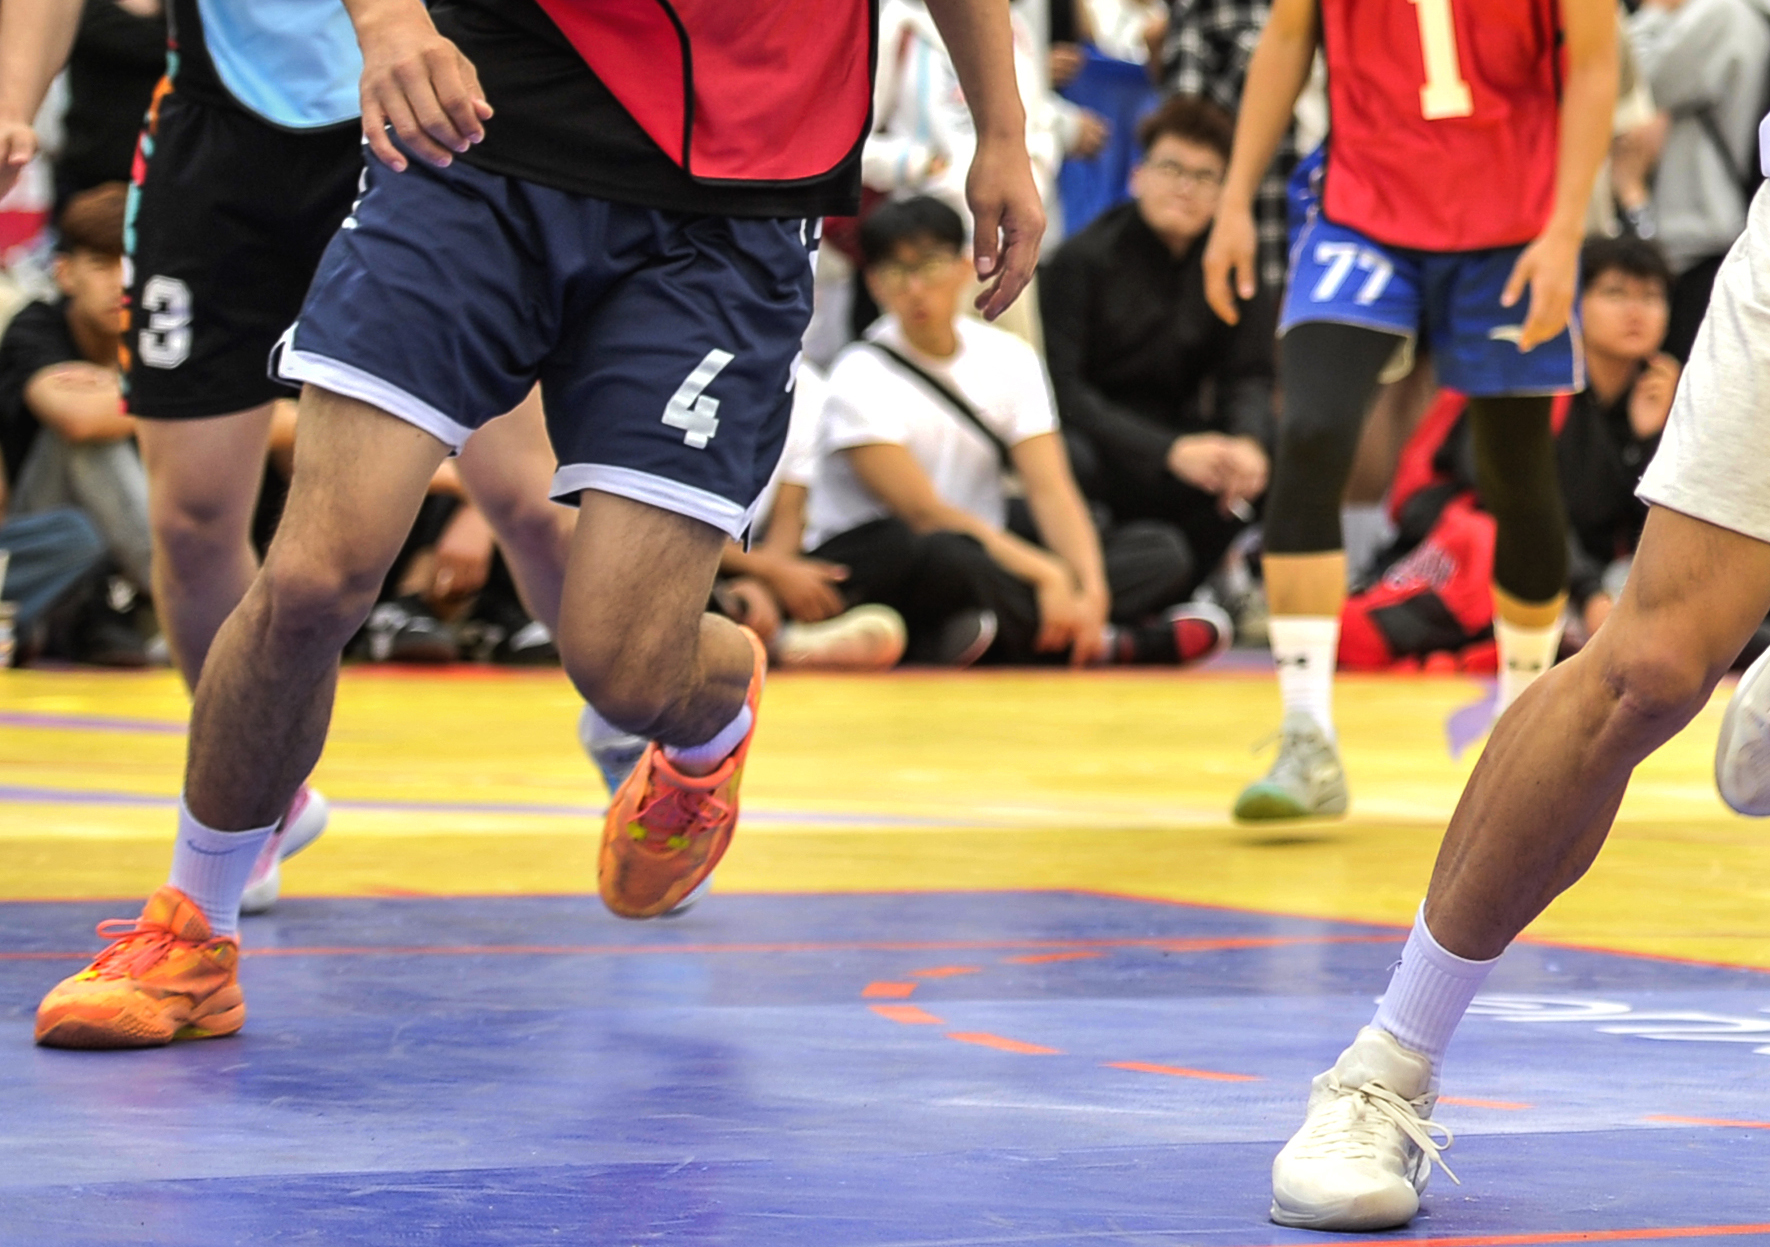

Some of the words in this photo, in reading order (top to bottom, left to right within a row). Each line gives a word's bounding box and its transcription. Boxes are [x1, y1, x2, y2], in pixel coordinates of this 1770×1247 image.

[1312, 239, 1394, 306] 77
[138, 274, 194, 370] 3
[661, 348, 735, 449] 4
